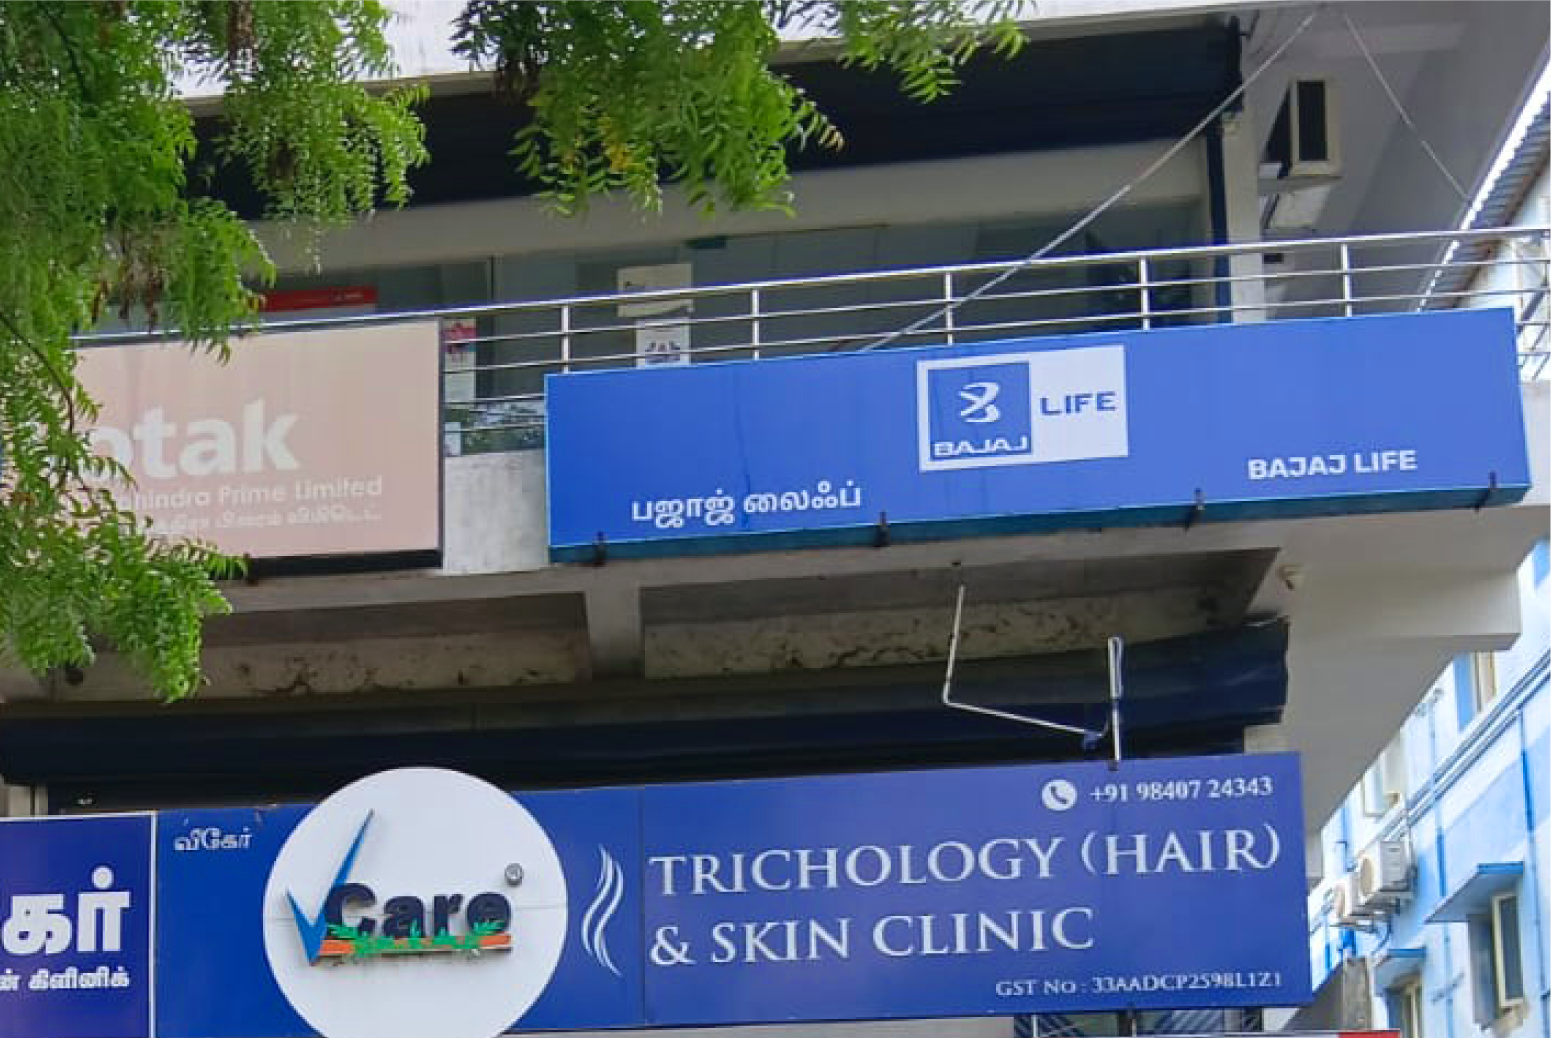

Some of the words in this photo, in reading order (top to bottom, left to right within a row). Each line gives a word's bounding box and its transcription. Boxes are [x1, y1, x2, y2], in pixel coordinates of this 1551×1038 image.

[1040, 391, 1117, 415] LIFE
[24, 398, 300, 480] otak
[934, 435, 1029, 457] BAJAJ
[1247, 454, 1348, 480] BAJAJ
[1354, 450, 1418, 474] LIFE
[219, 484, 286, 504] Prime
[295, 475, 384, 500] Limited
[631, 488, 735, 529] பஜாஜ்
[743, 479, 862, 514] லைஃப்
[1090, 783, 1129, 803] +91
[1136, 779, 1201, 801] 98407
[1207, 775, 1274, 798] 24343
[649, 836, 1065, 897] TRICHOLOGY
[1081, 821, 1280, 877] (HAIR)
[650, 926, 697, 966] &
[711, 917, 852, 963] SKIN
[872, 906, 1095, 957] CLINIC
[996, 979, 1037, 996] GST
